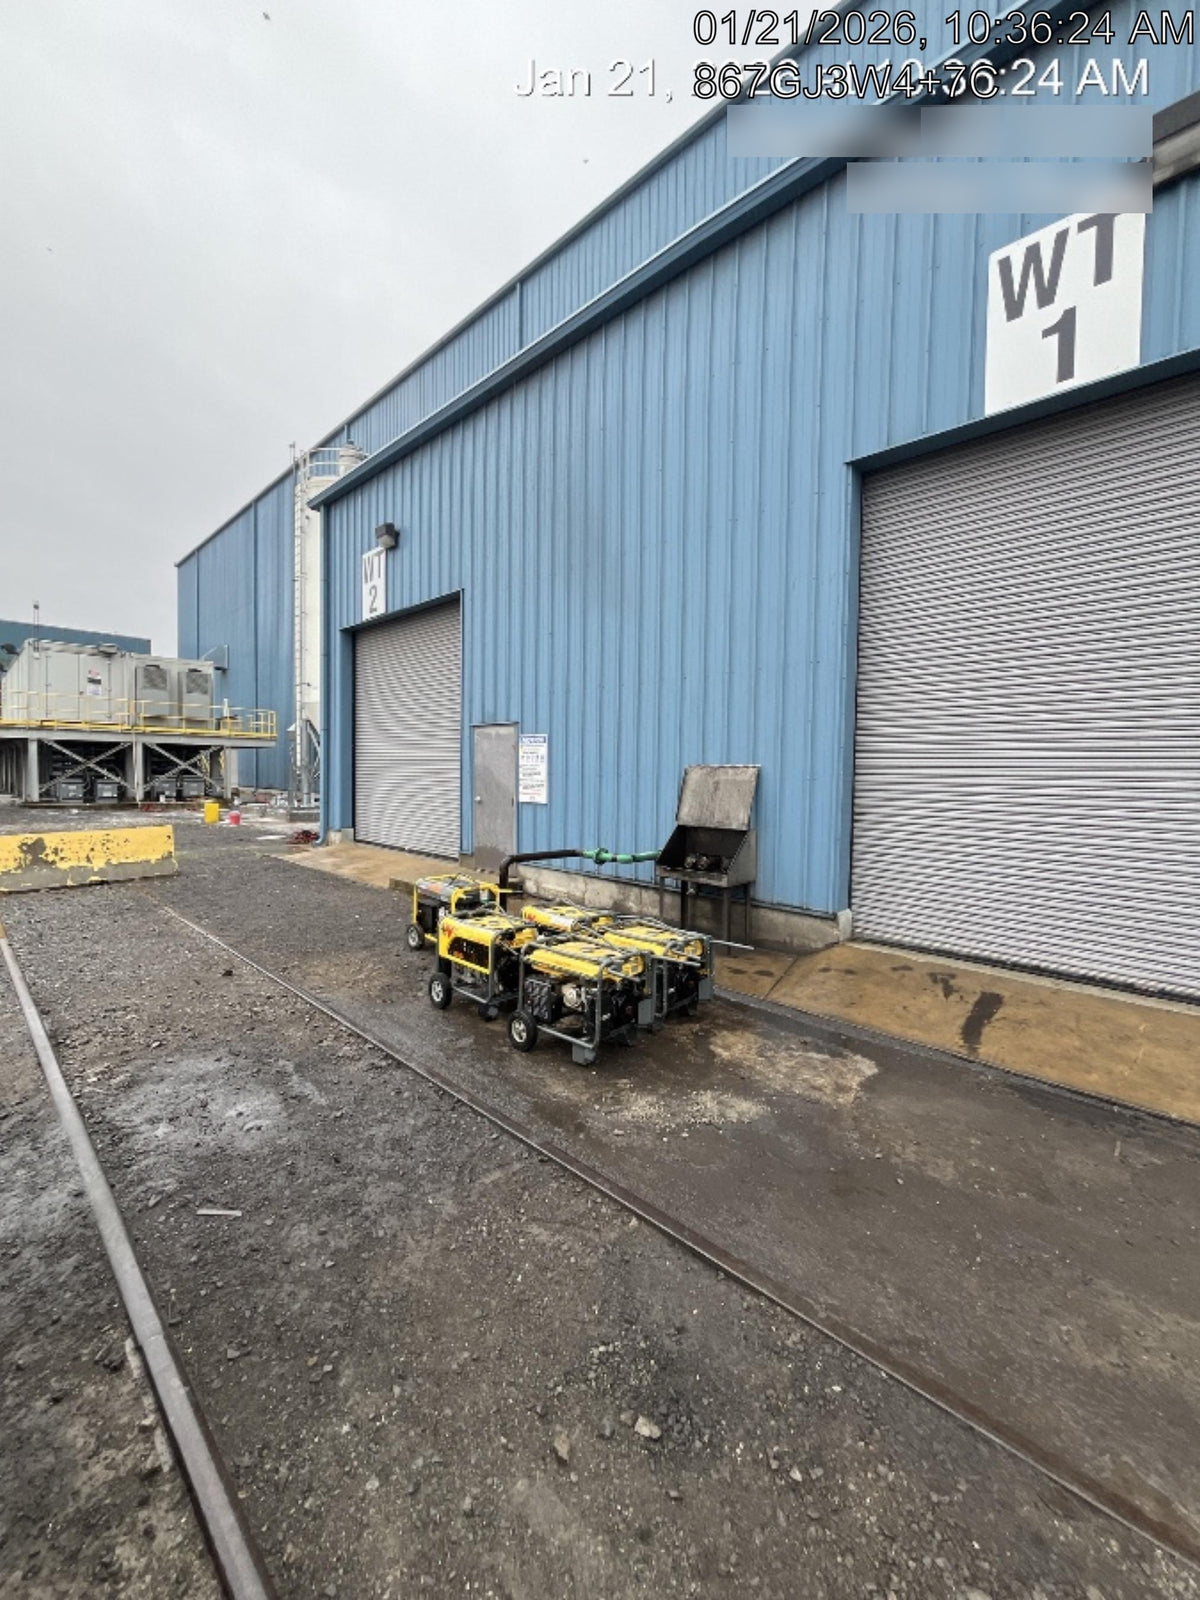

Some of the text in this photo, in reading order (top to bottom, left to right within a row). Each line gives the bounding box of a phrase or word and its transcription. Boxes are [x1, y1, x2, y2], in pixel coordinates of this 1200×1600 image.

[998, 213, 1123, 322] WT
[1041, 305, 1077, 384] 1
[369, 585, 378, 613] 2
